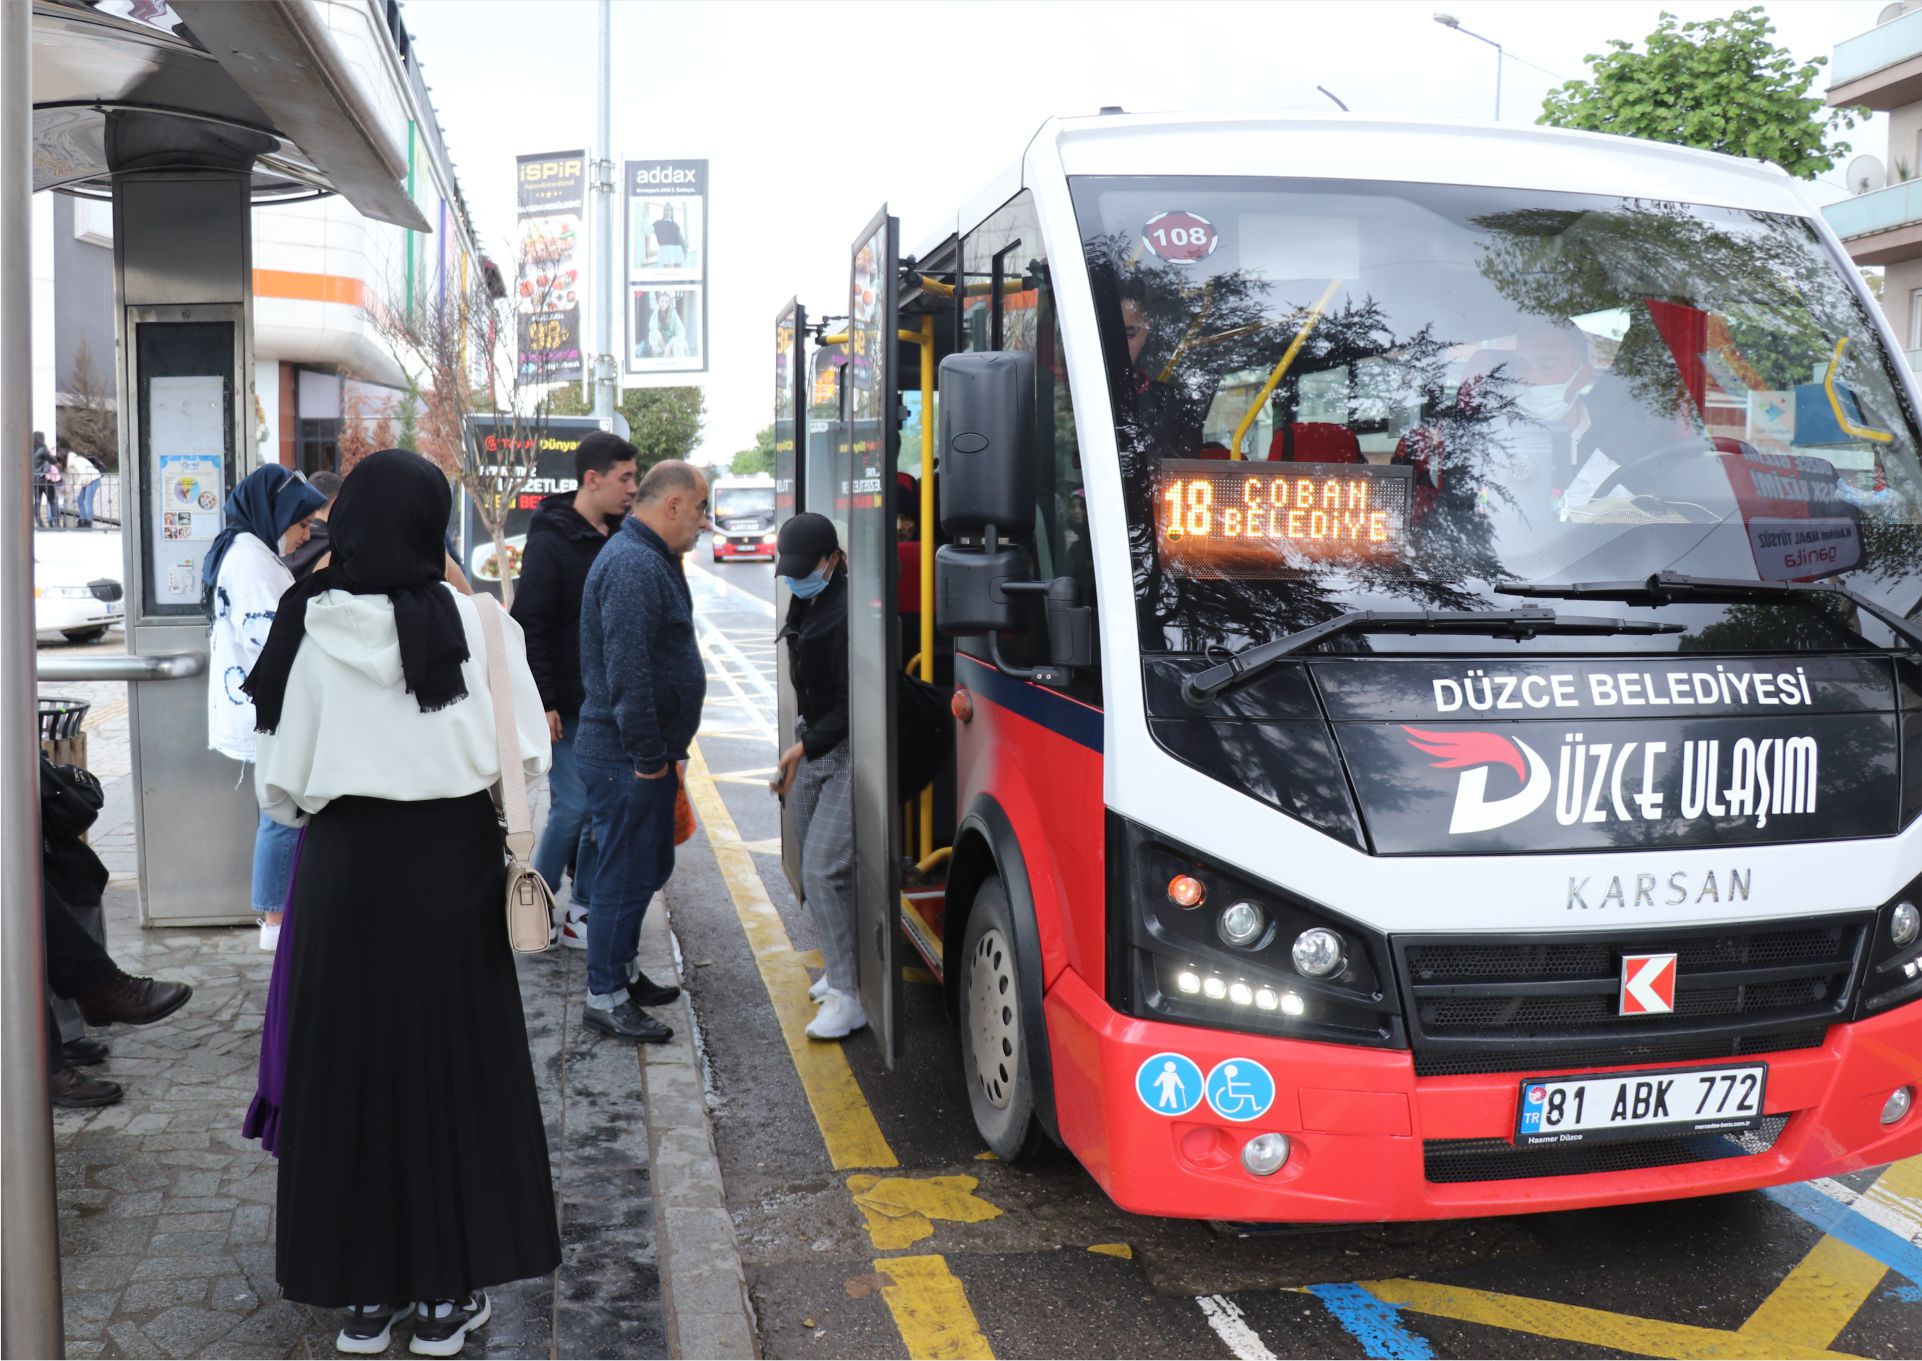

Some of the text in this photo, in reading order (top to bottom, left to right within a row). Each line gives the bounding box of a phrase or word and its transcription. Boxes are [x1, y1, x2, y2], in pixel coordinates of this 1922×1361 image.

[636, 165, 697, 185] addax
[1152, 227, 1208, 248] 108
[1164, 479, 1212, 537] 18
[1244, 478, 1369, 509] ÇOBAN
[1223, 507, 1388, 542] BELEDİYE
[1432, 664, 1812, 713] DÜZCE BELEDİYESİ
[1449, 732, 1818, 835] DÜZCE ULAŞIM
[1566, 867, 1753, 910] KARSAN
[1524, 1073, 1758, 1126] TR 81 ABK 772
[1528, 1135, 1559, 1144] Hasmer
[1559, 1133, 1583, 1142] Düzce
